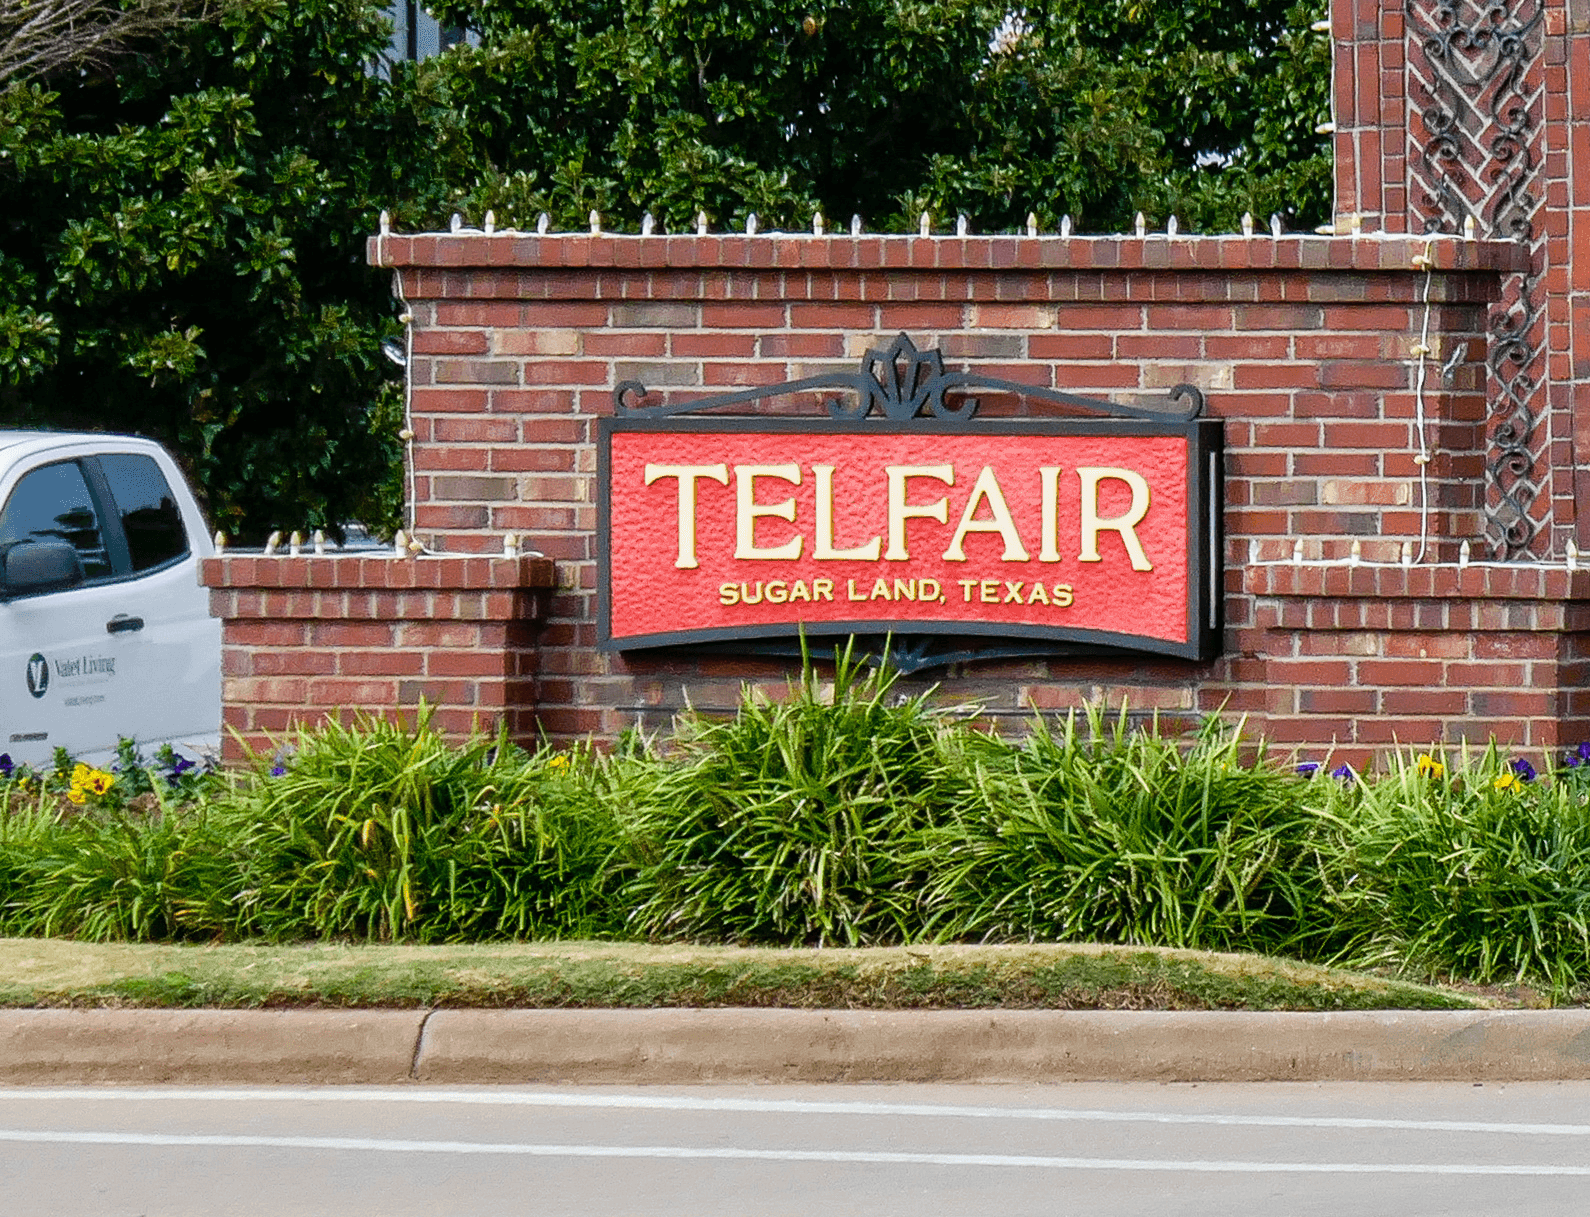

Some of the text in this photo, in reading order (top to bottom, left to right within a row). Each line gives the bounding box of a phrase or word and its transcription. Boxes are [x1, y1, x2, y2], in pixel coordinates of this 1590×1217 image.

[644, 463, 1154, 572] TELFAIR
[719, 578, 1074, 607] SUGAR LAND, TEXAS
[82, 655, 115, 676] Living
